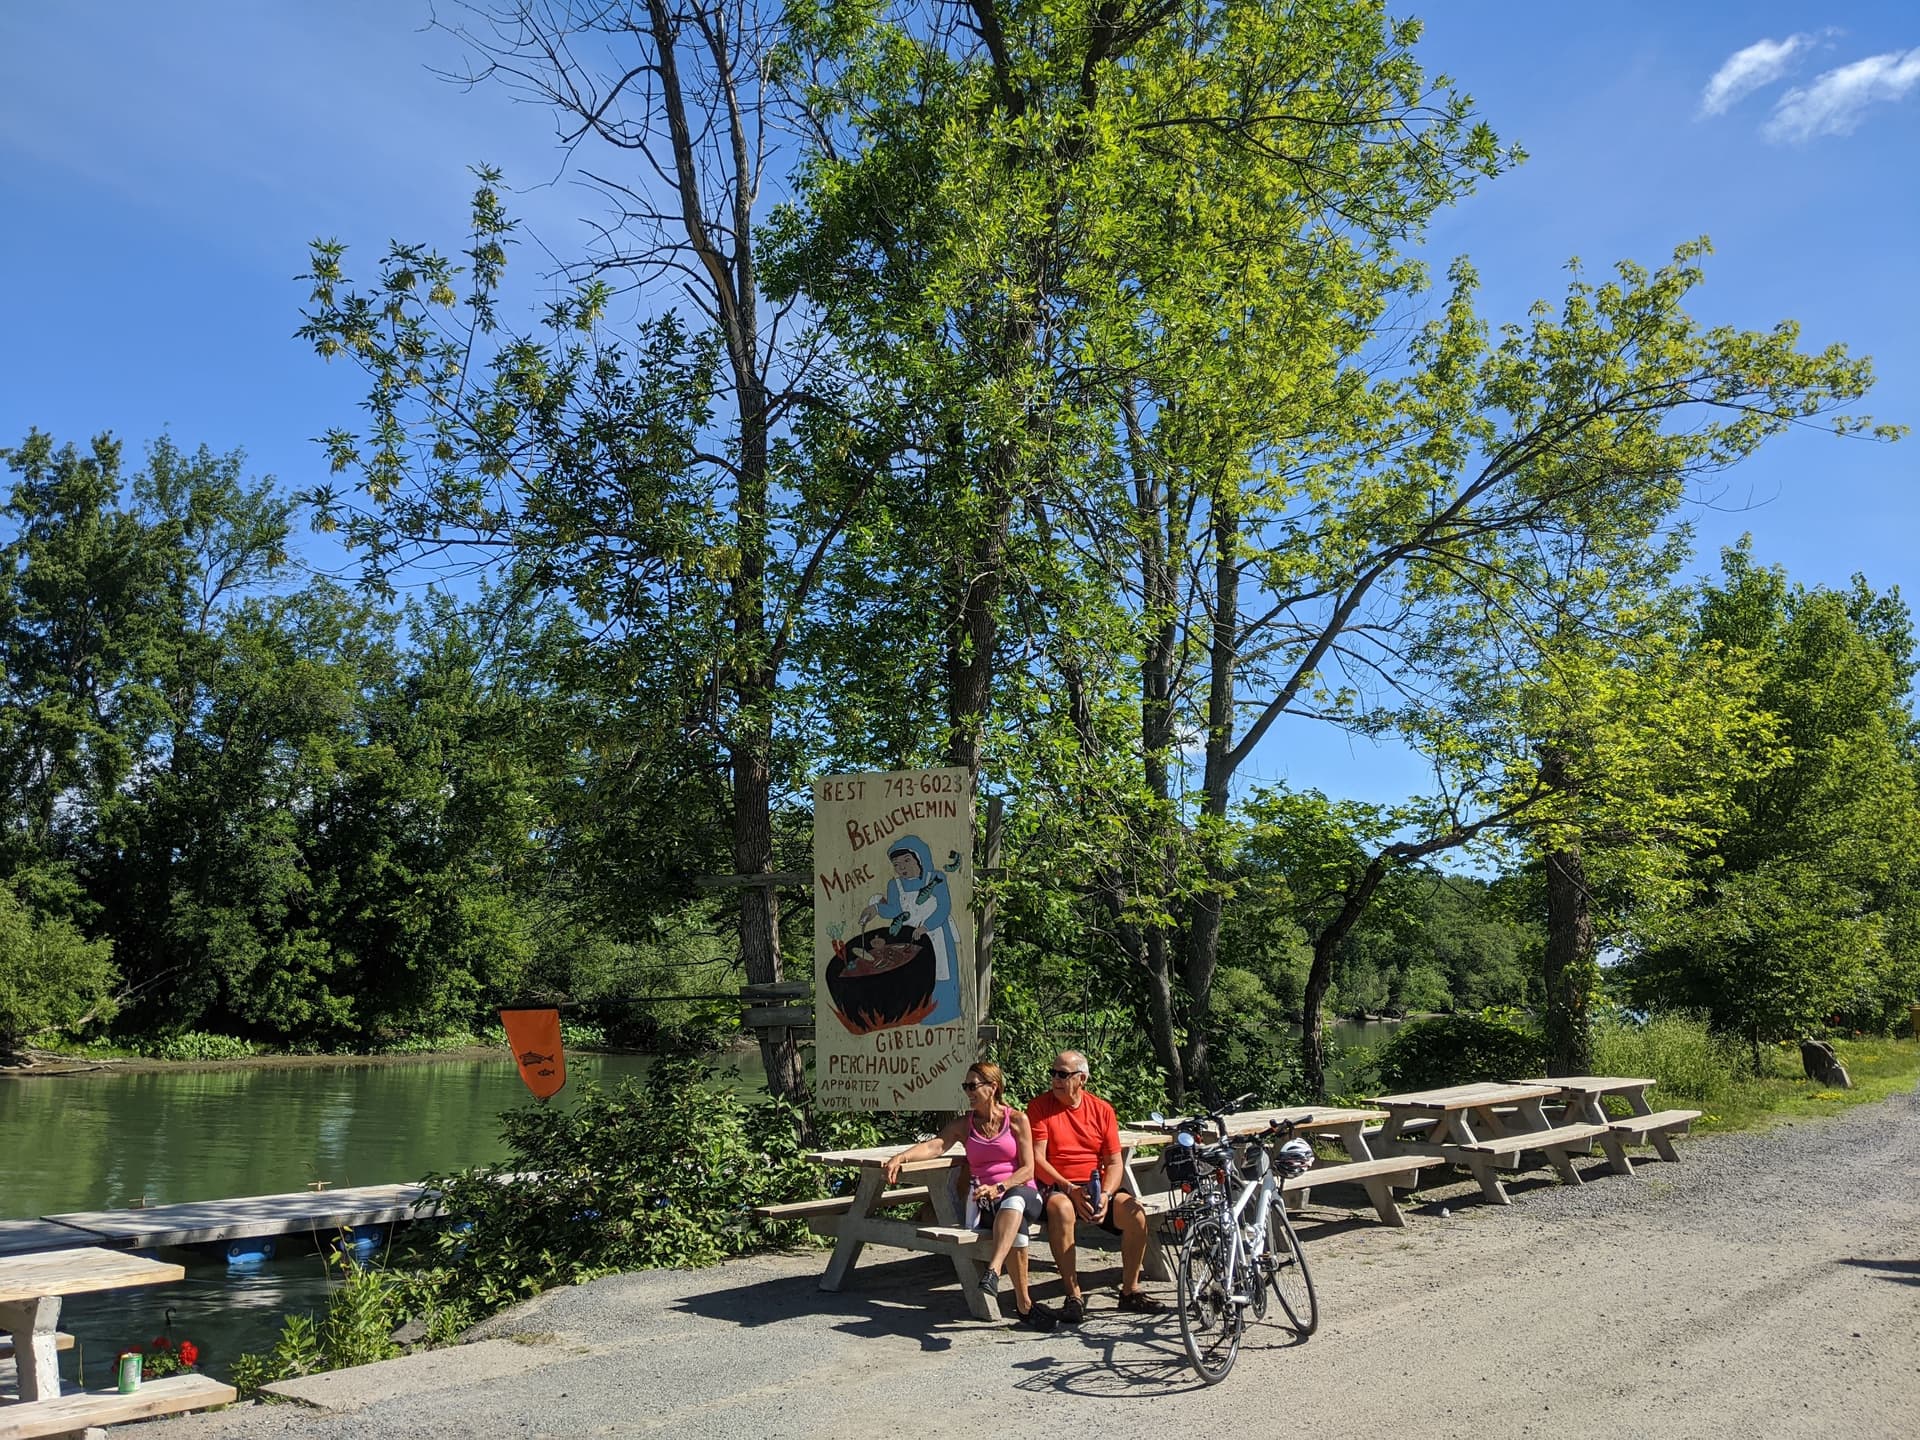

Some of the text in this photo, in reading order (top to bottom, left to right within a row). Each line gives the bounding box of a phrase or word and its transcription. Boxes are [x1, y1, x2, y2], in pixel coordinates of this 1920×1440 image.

[884, 774, 962, 798] 743-6023
[846, 800, 957, 852] BEAUCHEMIN
[819, 863, 875, 901] MARC
[876, 1027, 965, 1053] GIBELOTTE
[830, 1055, 920, 1074] PERCHAUDE
[905, 1046, 963, 1093] VOLONTÉ
[821, 1079, 880, 1092] APPORTEZ
[861, 1097, 879, 1107] VIN
